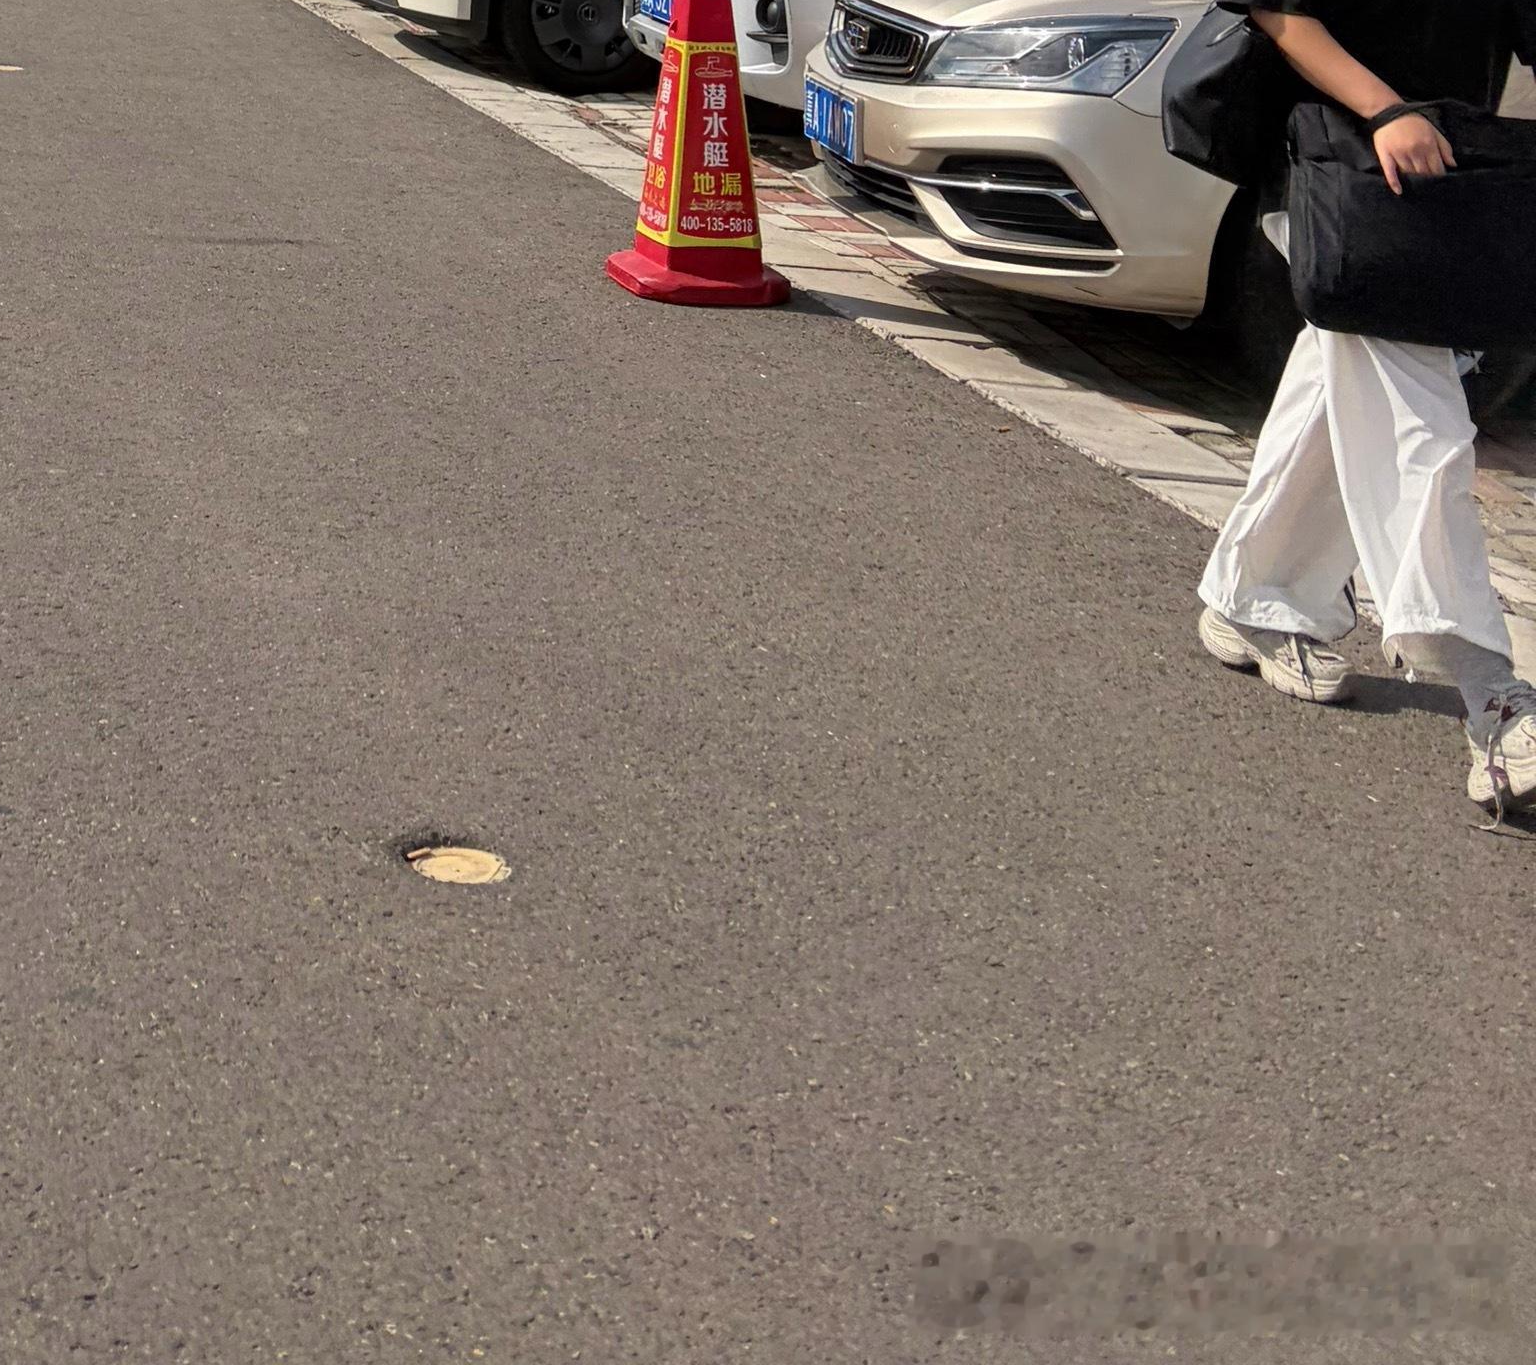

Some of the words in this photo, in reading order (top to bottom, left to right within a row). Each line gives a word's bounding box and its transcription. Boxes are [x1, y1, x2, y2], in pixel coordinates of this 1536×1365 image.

[703, 83, 729, 167] 潜水艇
[693, 171, 742, 196] 地漏
[681, 215, 754, 233] 400-135-5818
